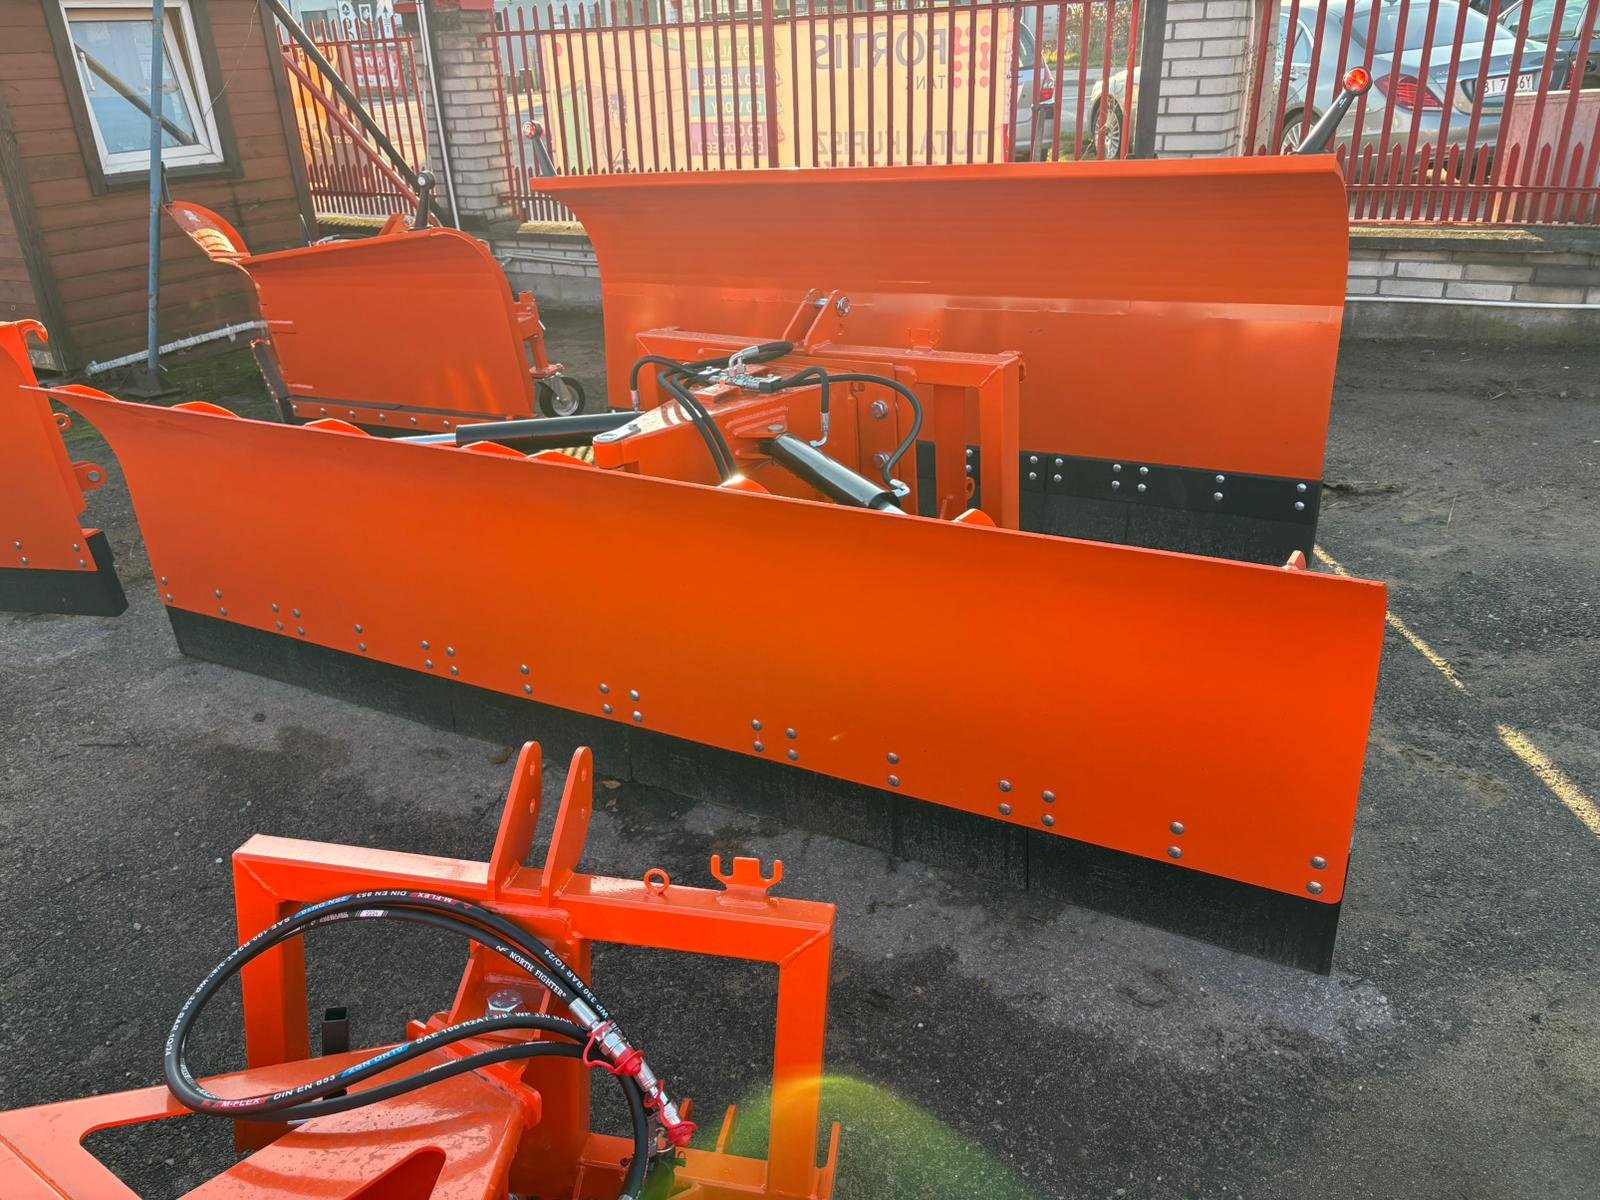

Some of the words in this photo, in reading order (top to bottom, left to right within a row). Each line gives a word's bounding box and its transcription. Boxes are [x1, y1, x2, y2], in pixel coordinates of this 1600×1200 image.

[417, 892, 453, 903] M-FLEX
[509, 951, 535, 972] NORTH
[566, 970, 584, 988] BAR
[583, 988, 597, 1003] 330
[596, 1004, 609, 1019] WP
[273, 1091, 294, 1100] DIN
[297, 1083, 313, 1093] EN
